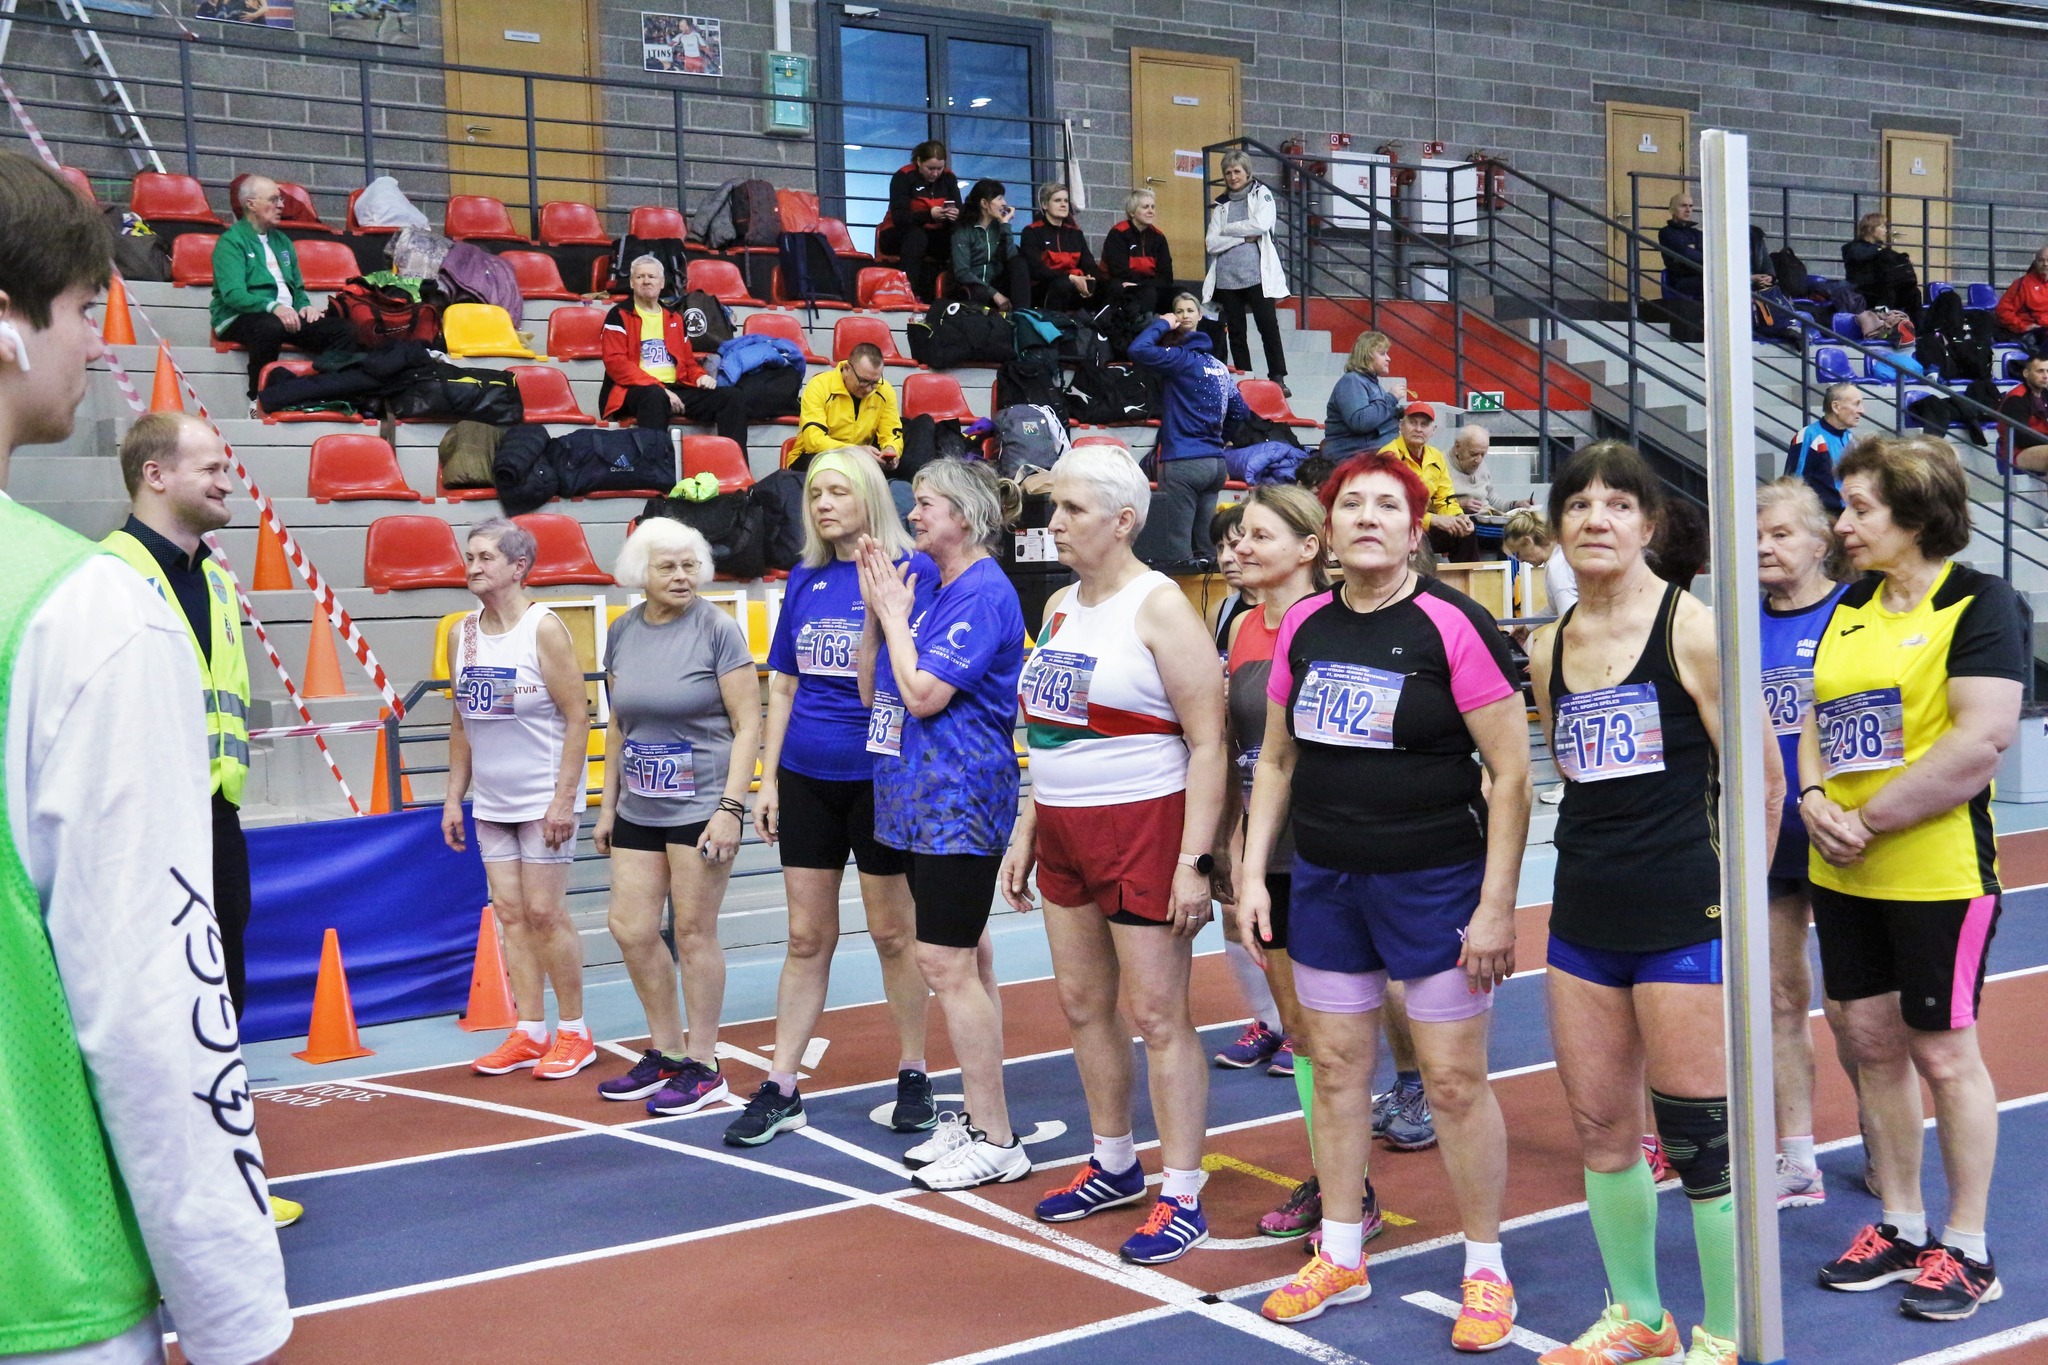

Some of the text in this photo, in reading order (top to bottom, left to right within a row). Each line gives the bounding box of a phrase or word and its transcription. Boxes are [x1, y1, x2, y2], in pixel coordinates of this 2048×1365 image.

[811, 632, 852, 669] 163
[929, 649, 969, 669] SPORTA CENTRS
[931, 643, 971, 664] OGRES NOVADA
[467, 681, 493, 712] 39
[513, 686, 538, 694] ATVIA
[1031, 666, 1073, 713] 143
[1763, 682, 1800, 726] 23
[867, 706, 893, 745] 53
[1316, 684, 1375, 737] 142
[1569, 711, 1637, 770] 173
[1829, 711, 1883, 766] 298
[635, 758, 679, 790] 172
[254, 1090, 332, 1107] 1000
[303, 1084, 387, 1102] 3000
